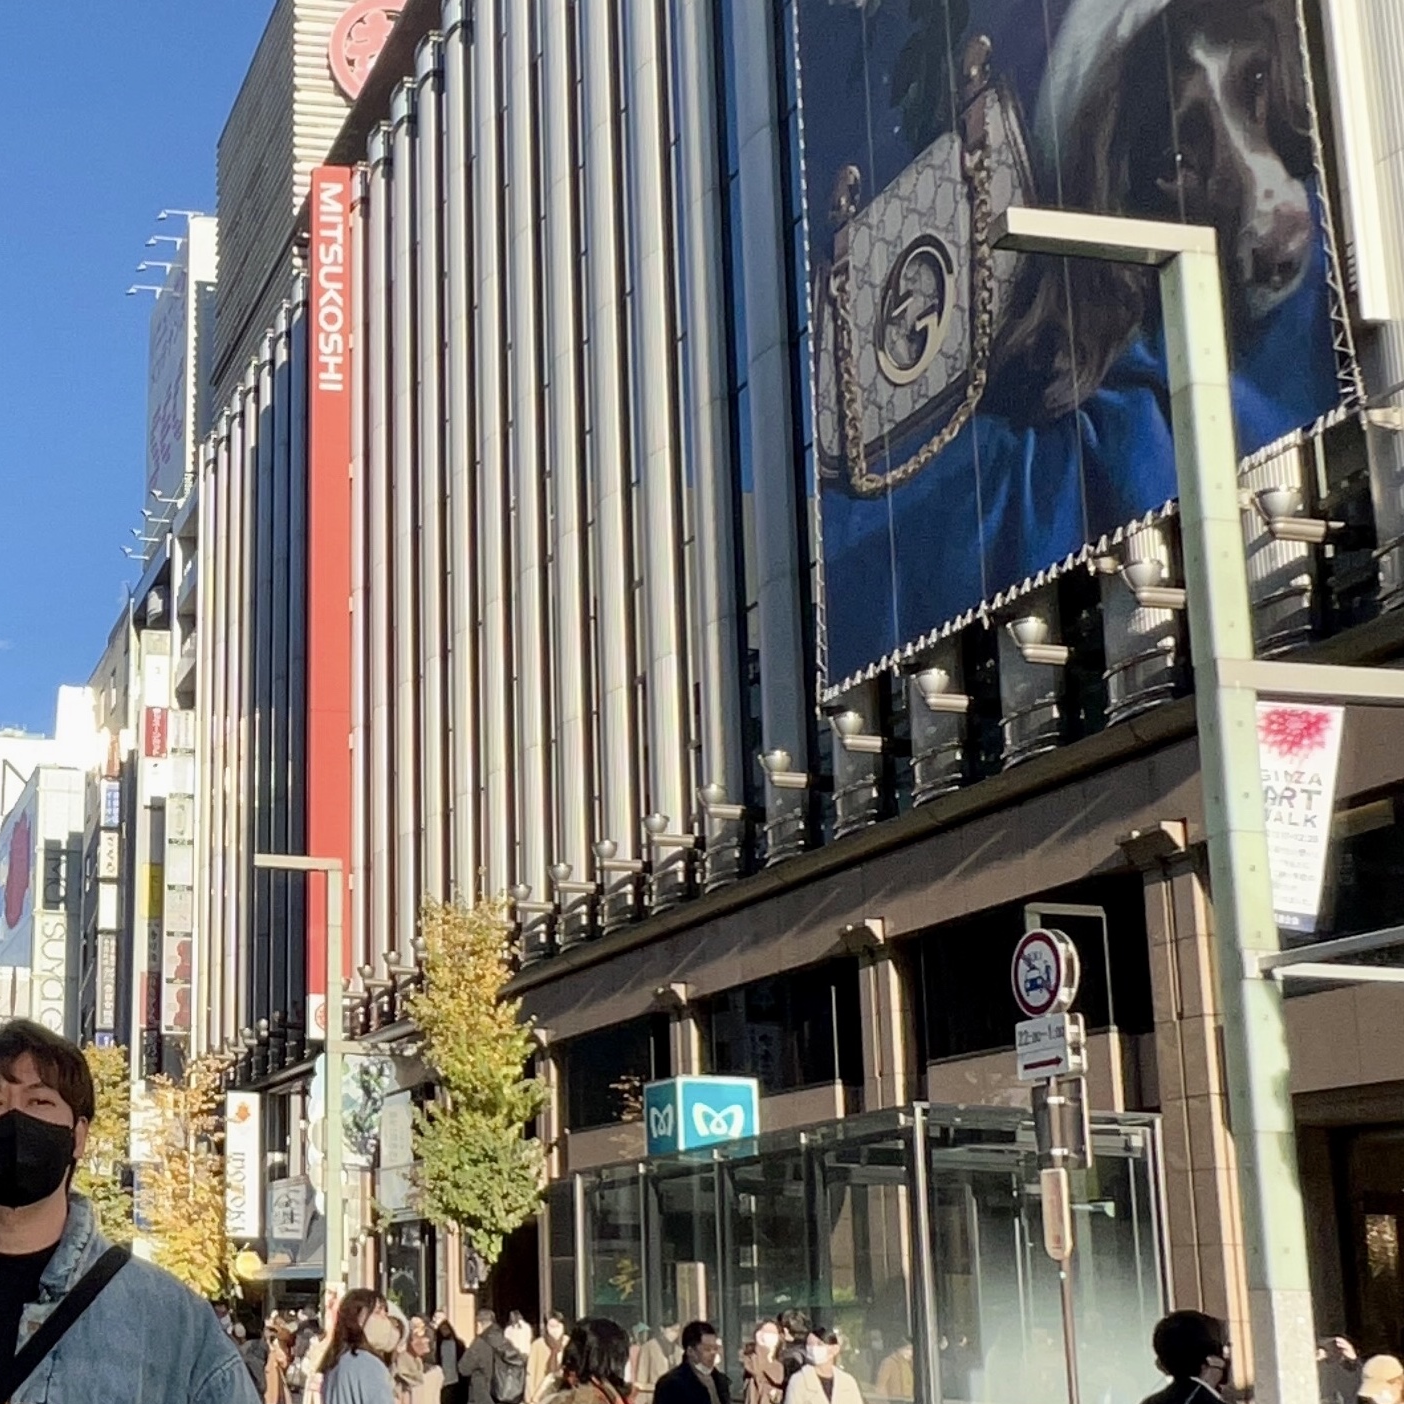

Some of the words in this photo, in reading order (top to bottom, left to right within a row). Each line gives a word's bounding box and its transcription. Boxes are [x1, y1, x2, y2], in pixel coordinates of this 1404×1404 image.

[318, 182, 344, 392] MITSUKOSHI
[1261, 769, 1323, 787] GINZA
[1263, 785, 1322, 811] ART
